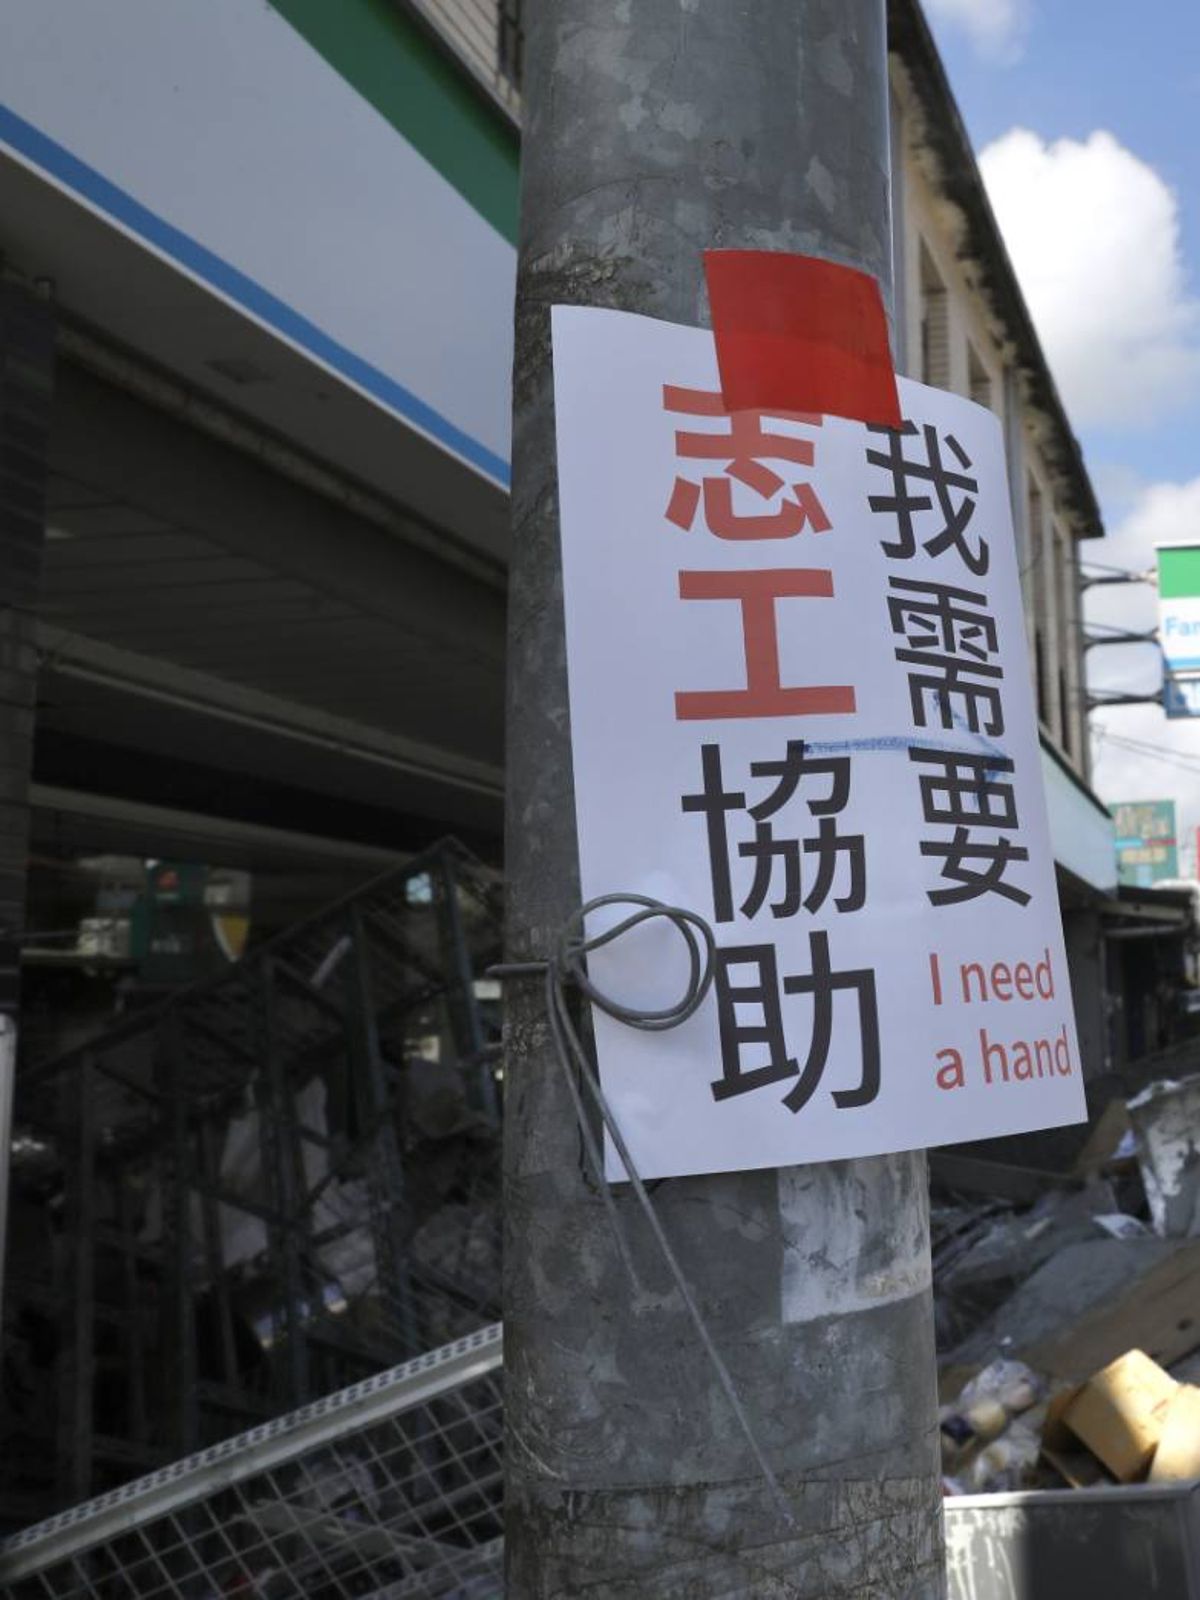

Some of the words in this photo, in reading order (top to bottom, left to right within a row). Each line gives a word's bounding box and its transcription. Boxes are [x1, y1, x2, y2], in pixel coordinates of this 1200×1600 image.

[663, 383, 880, 1116] 志工協助
[866, 421, 1031, 908] 我需要
[931, 954, 942, 1005] I
[962, 948, 1055, 1004] need
[936, 1046, 964, 1090] a
[983, 1025, 1073, 1086] hand
